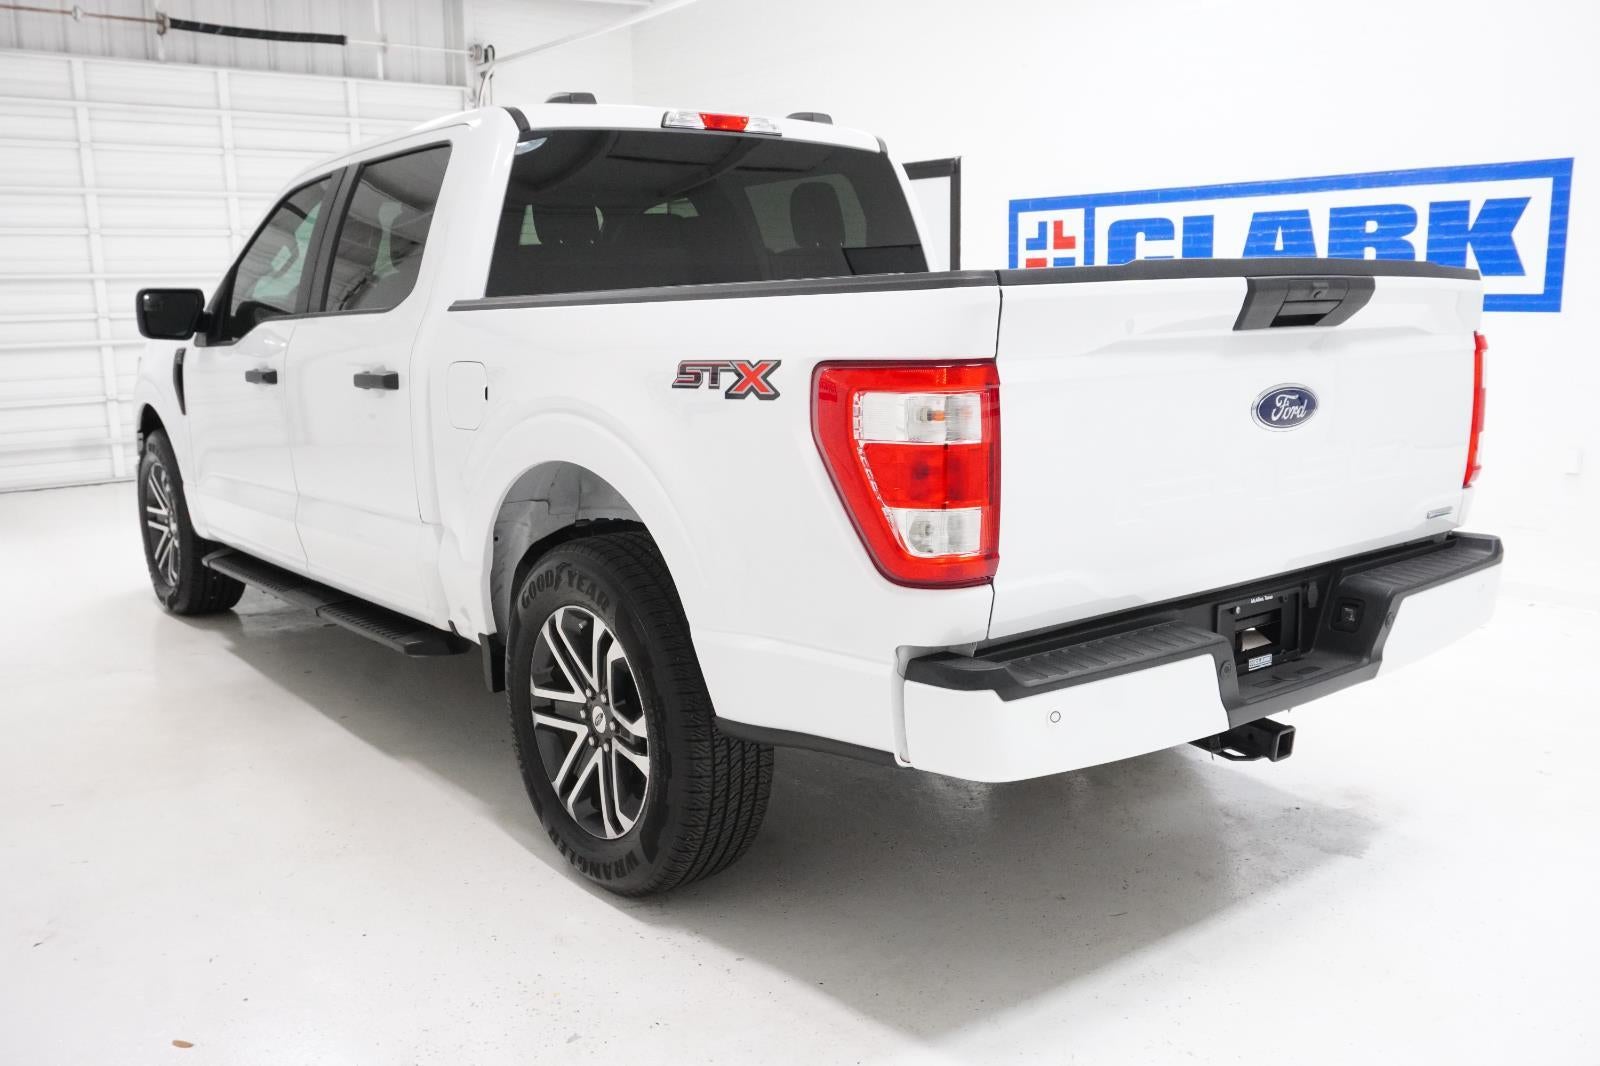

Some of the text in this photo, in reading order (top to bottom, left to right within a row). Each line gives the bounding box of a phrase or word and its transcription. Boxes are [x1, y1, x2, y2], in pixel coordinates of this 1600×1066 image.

[1107, 197, 1532, 277] CLARK
[672, 359, 782, 400] STX
[1271, 394, 1308, 421] Ford
[548, 826, 640, 881] WRANGLER
